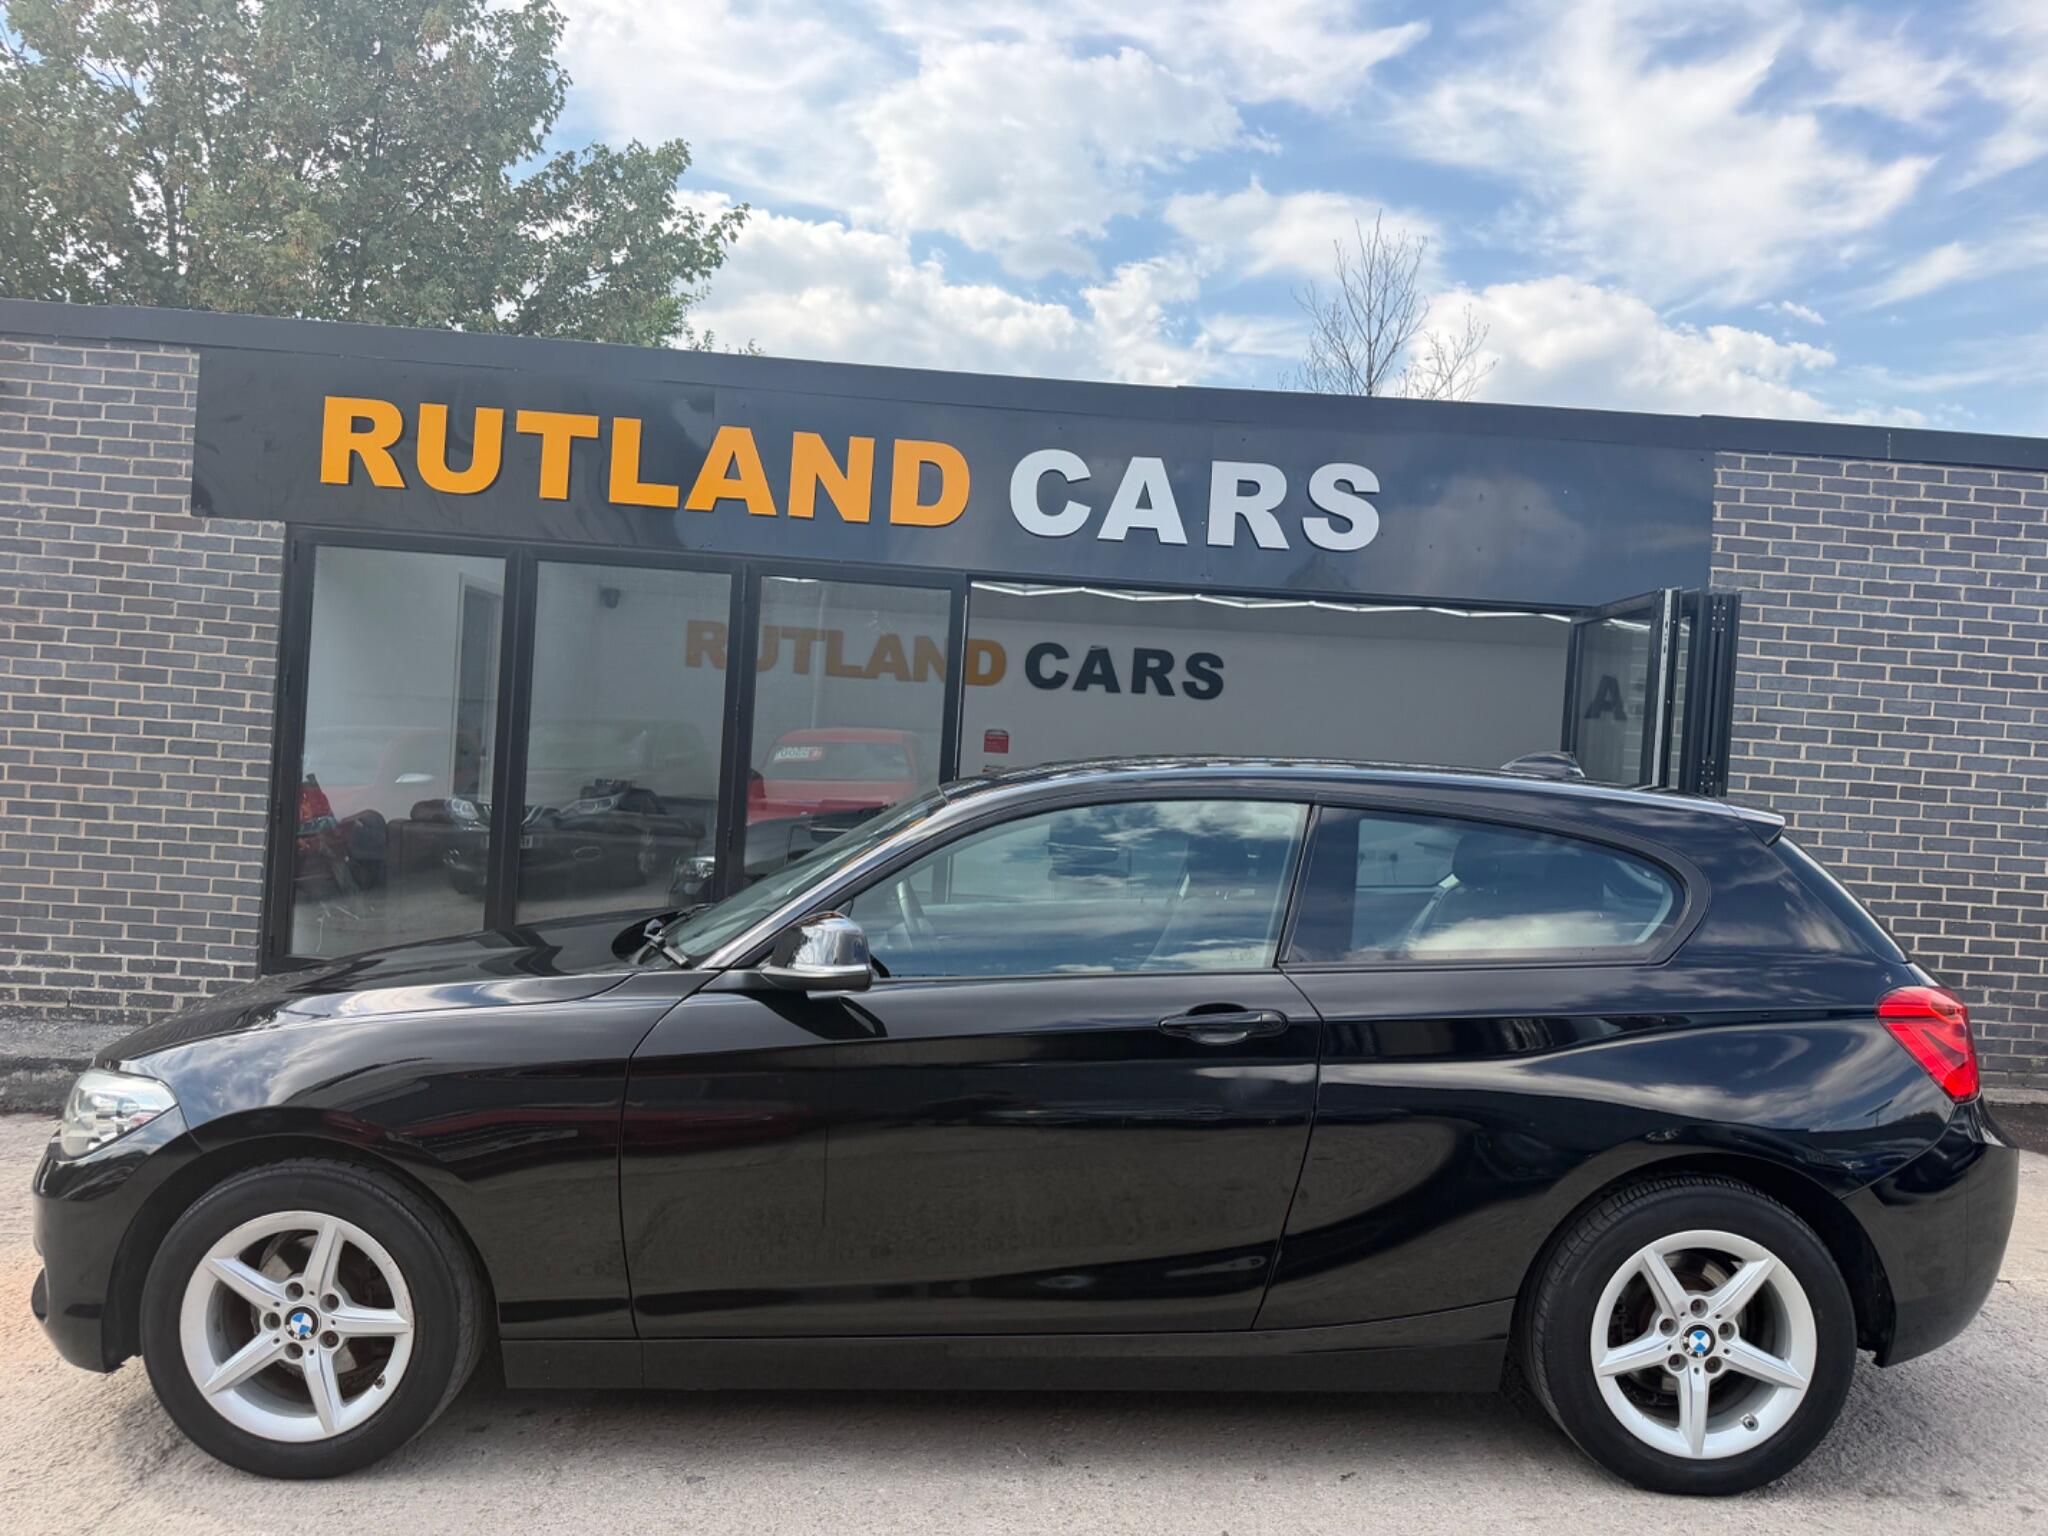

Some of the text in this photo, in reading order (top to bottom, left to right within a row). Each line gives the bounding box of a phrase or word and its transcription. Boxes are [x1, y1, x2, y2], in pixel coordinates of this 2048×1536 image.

[320, 396, 1381, 552] RUTLAND CARS
[1024, 641, 1224, 700] CARS
